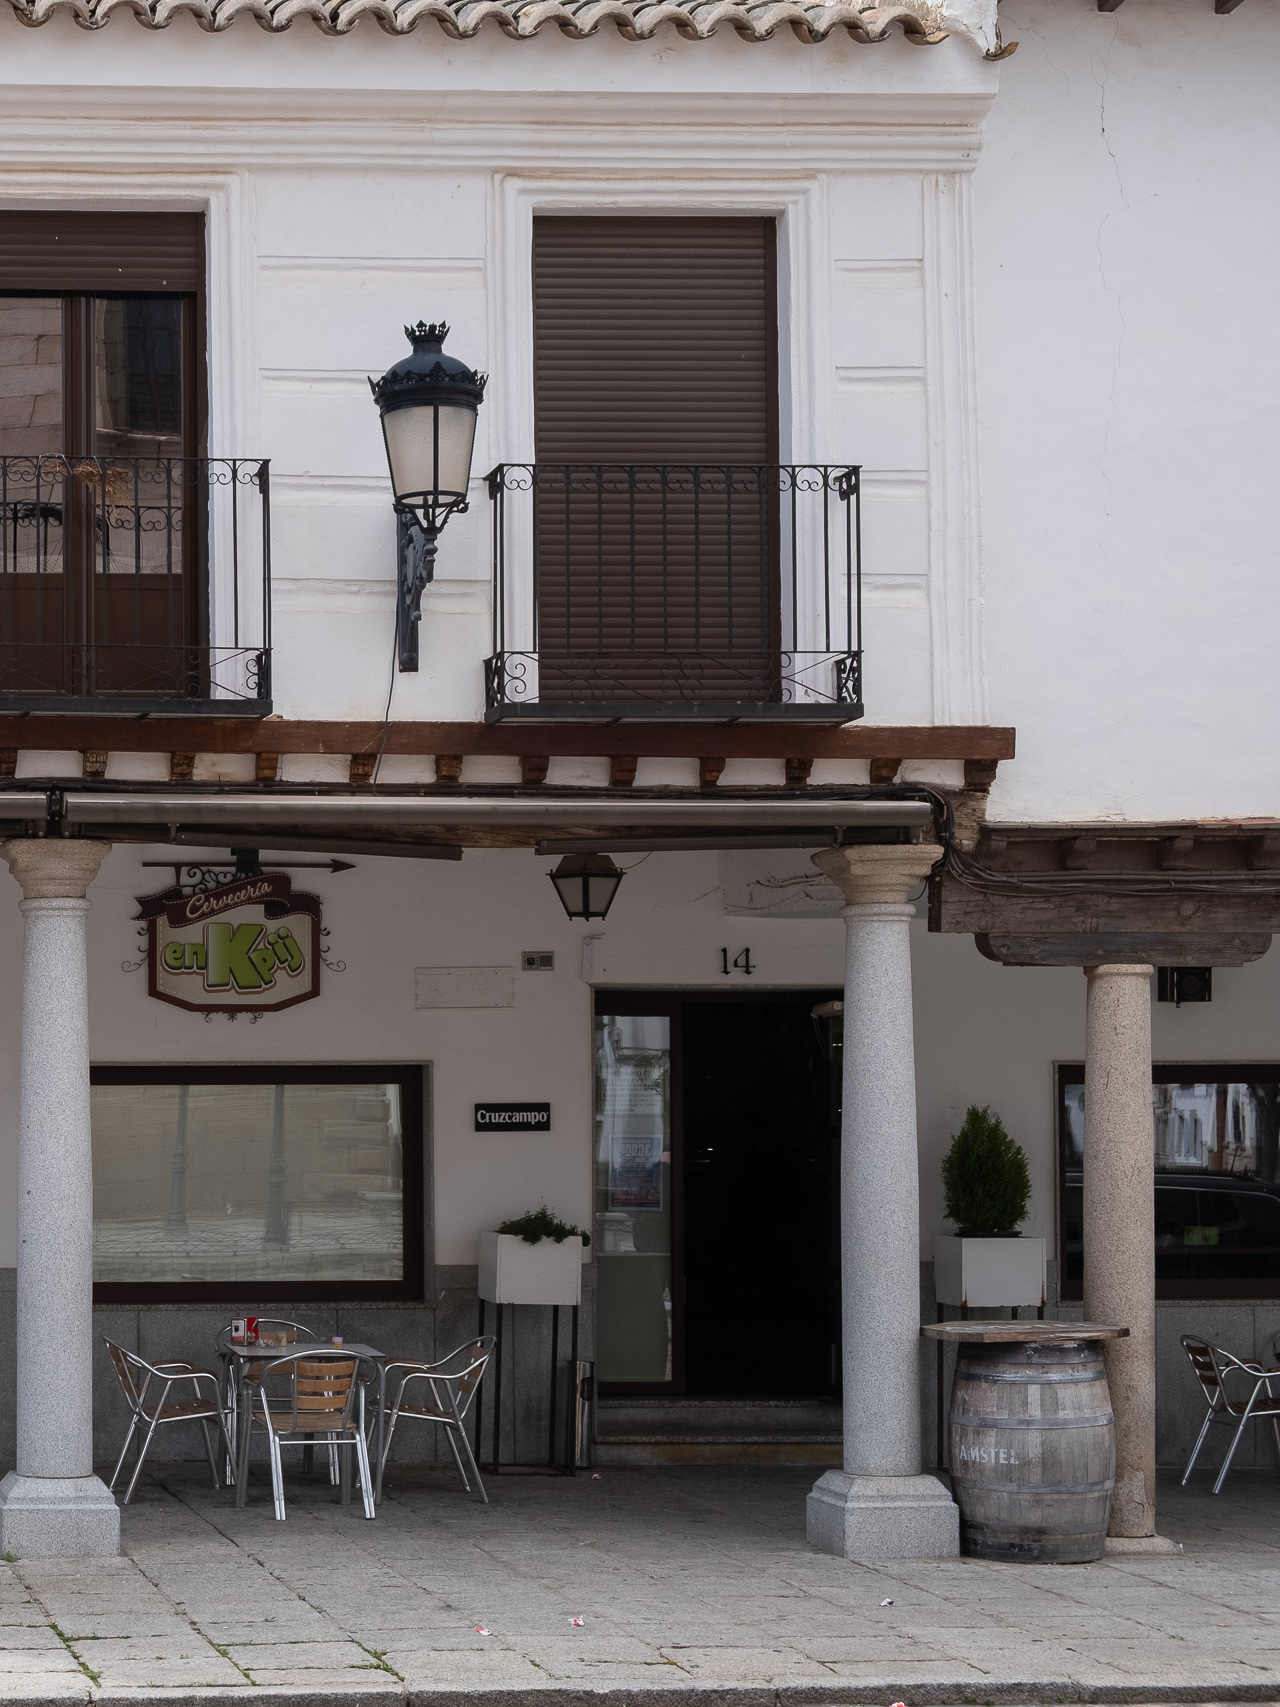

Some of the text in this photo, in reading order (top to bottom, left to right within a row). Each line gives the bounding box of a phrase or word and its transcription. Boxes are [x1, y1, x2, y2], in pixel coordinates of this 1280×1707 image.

[186, 882, 273, 919] Cervecería
[721, 947, 756, 976] 14
[477, 1109, 548, 1125] Cruzcampo
[960, 1445, 1019, 1464] AMSTEL
